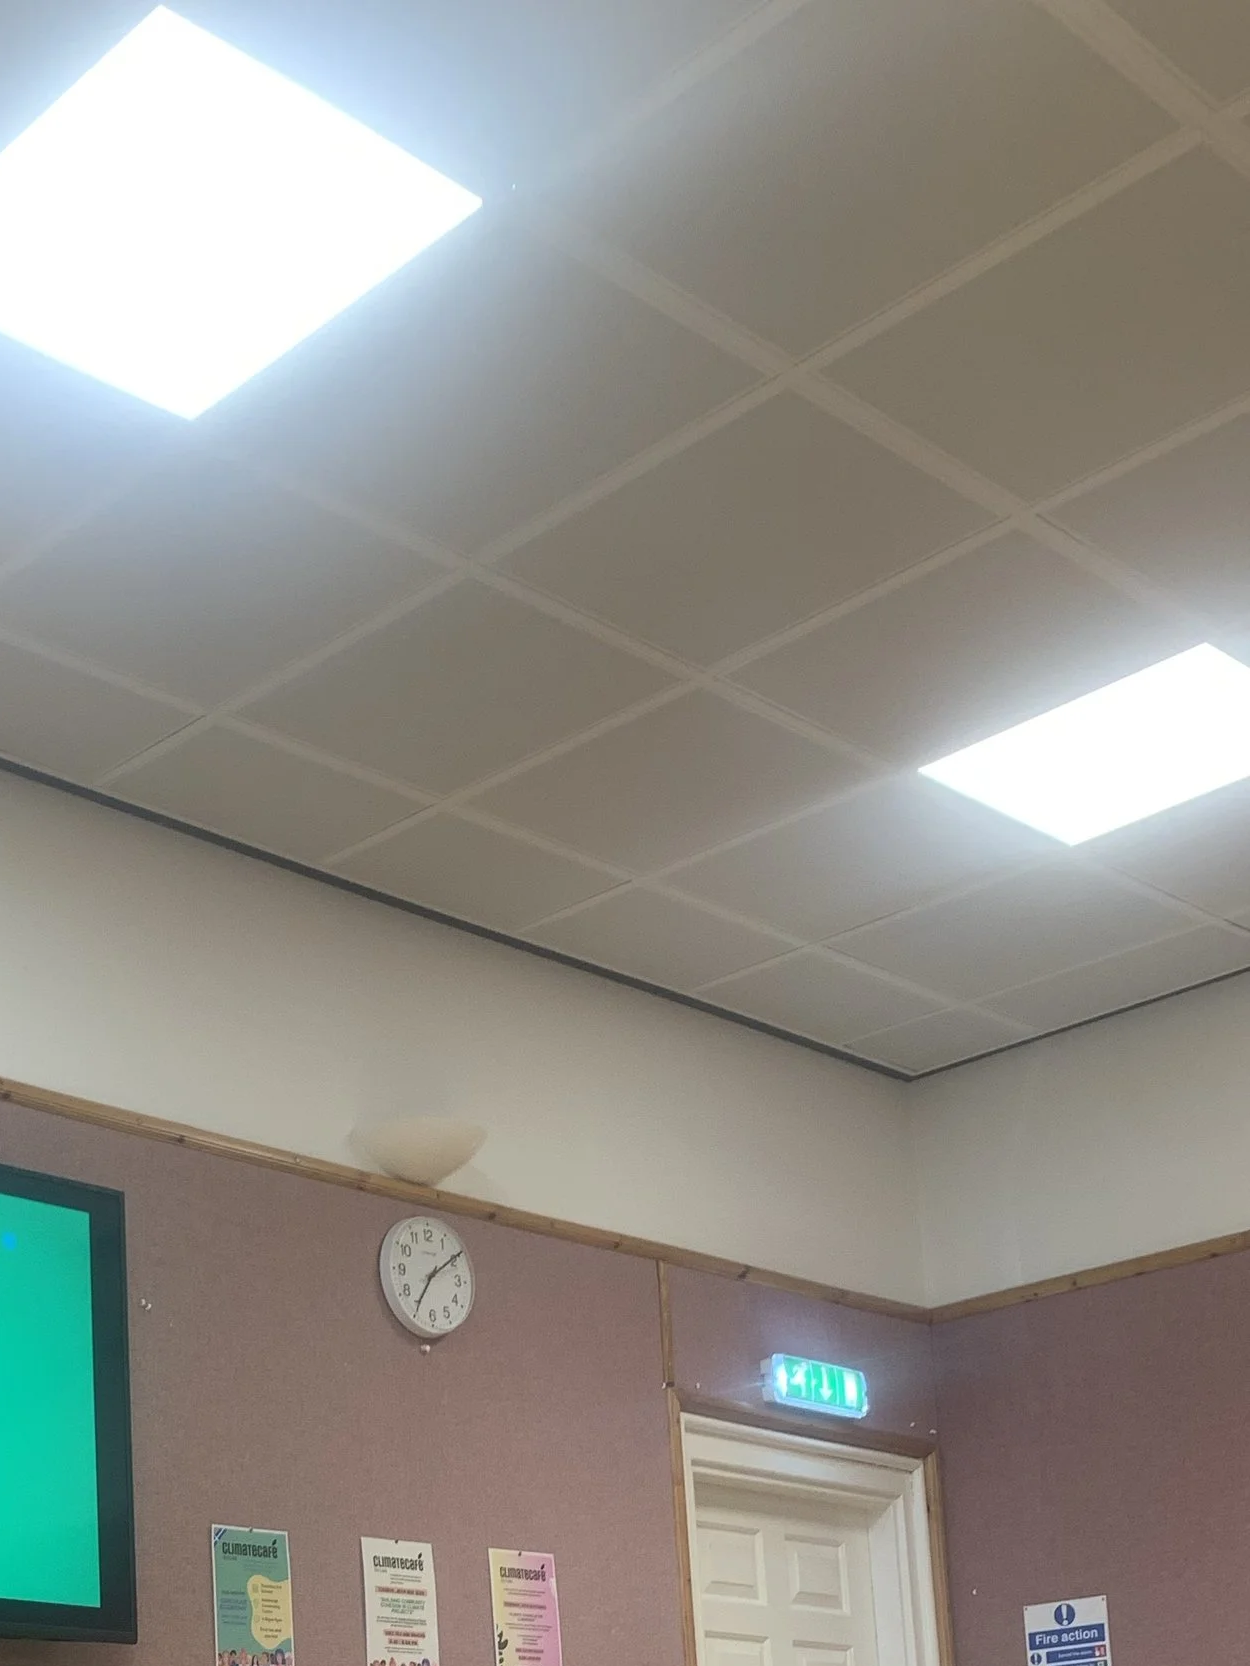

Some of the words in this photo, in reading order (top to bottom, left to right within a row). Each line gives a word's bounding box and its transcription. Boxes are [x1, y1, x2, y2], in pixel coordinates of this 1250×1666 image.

[410, 1231, 418, 1244] 11
[423, 1229, 433, 1242] 12
[400, 1243, 411, 1257] 10
[398, 1263, 406, 1276] 9
[454, 1274, 462, 1287] 3
[403, 1283, 411, 1297] 8
[451, 1293, 458, 1306] 4
[429, 1309, 436, 1322] 6
[443, 1306, 450, 1319] 5
[1035, 1634, 1058, 1645] Fire
[1061, 1628, 1098, 1642] action
